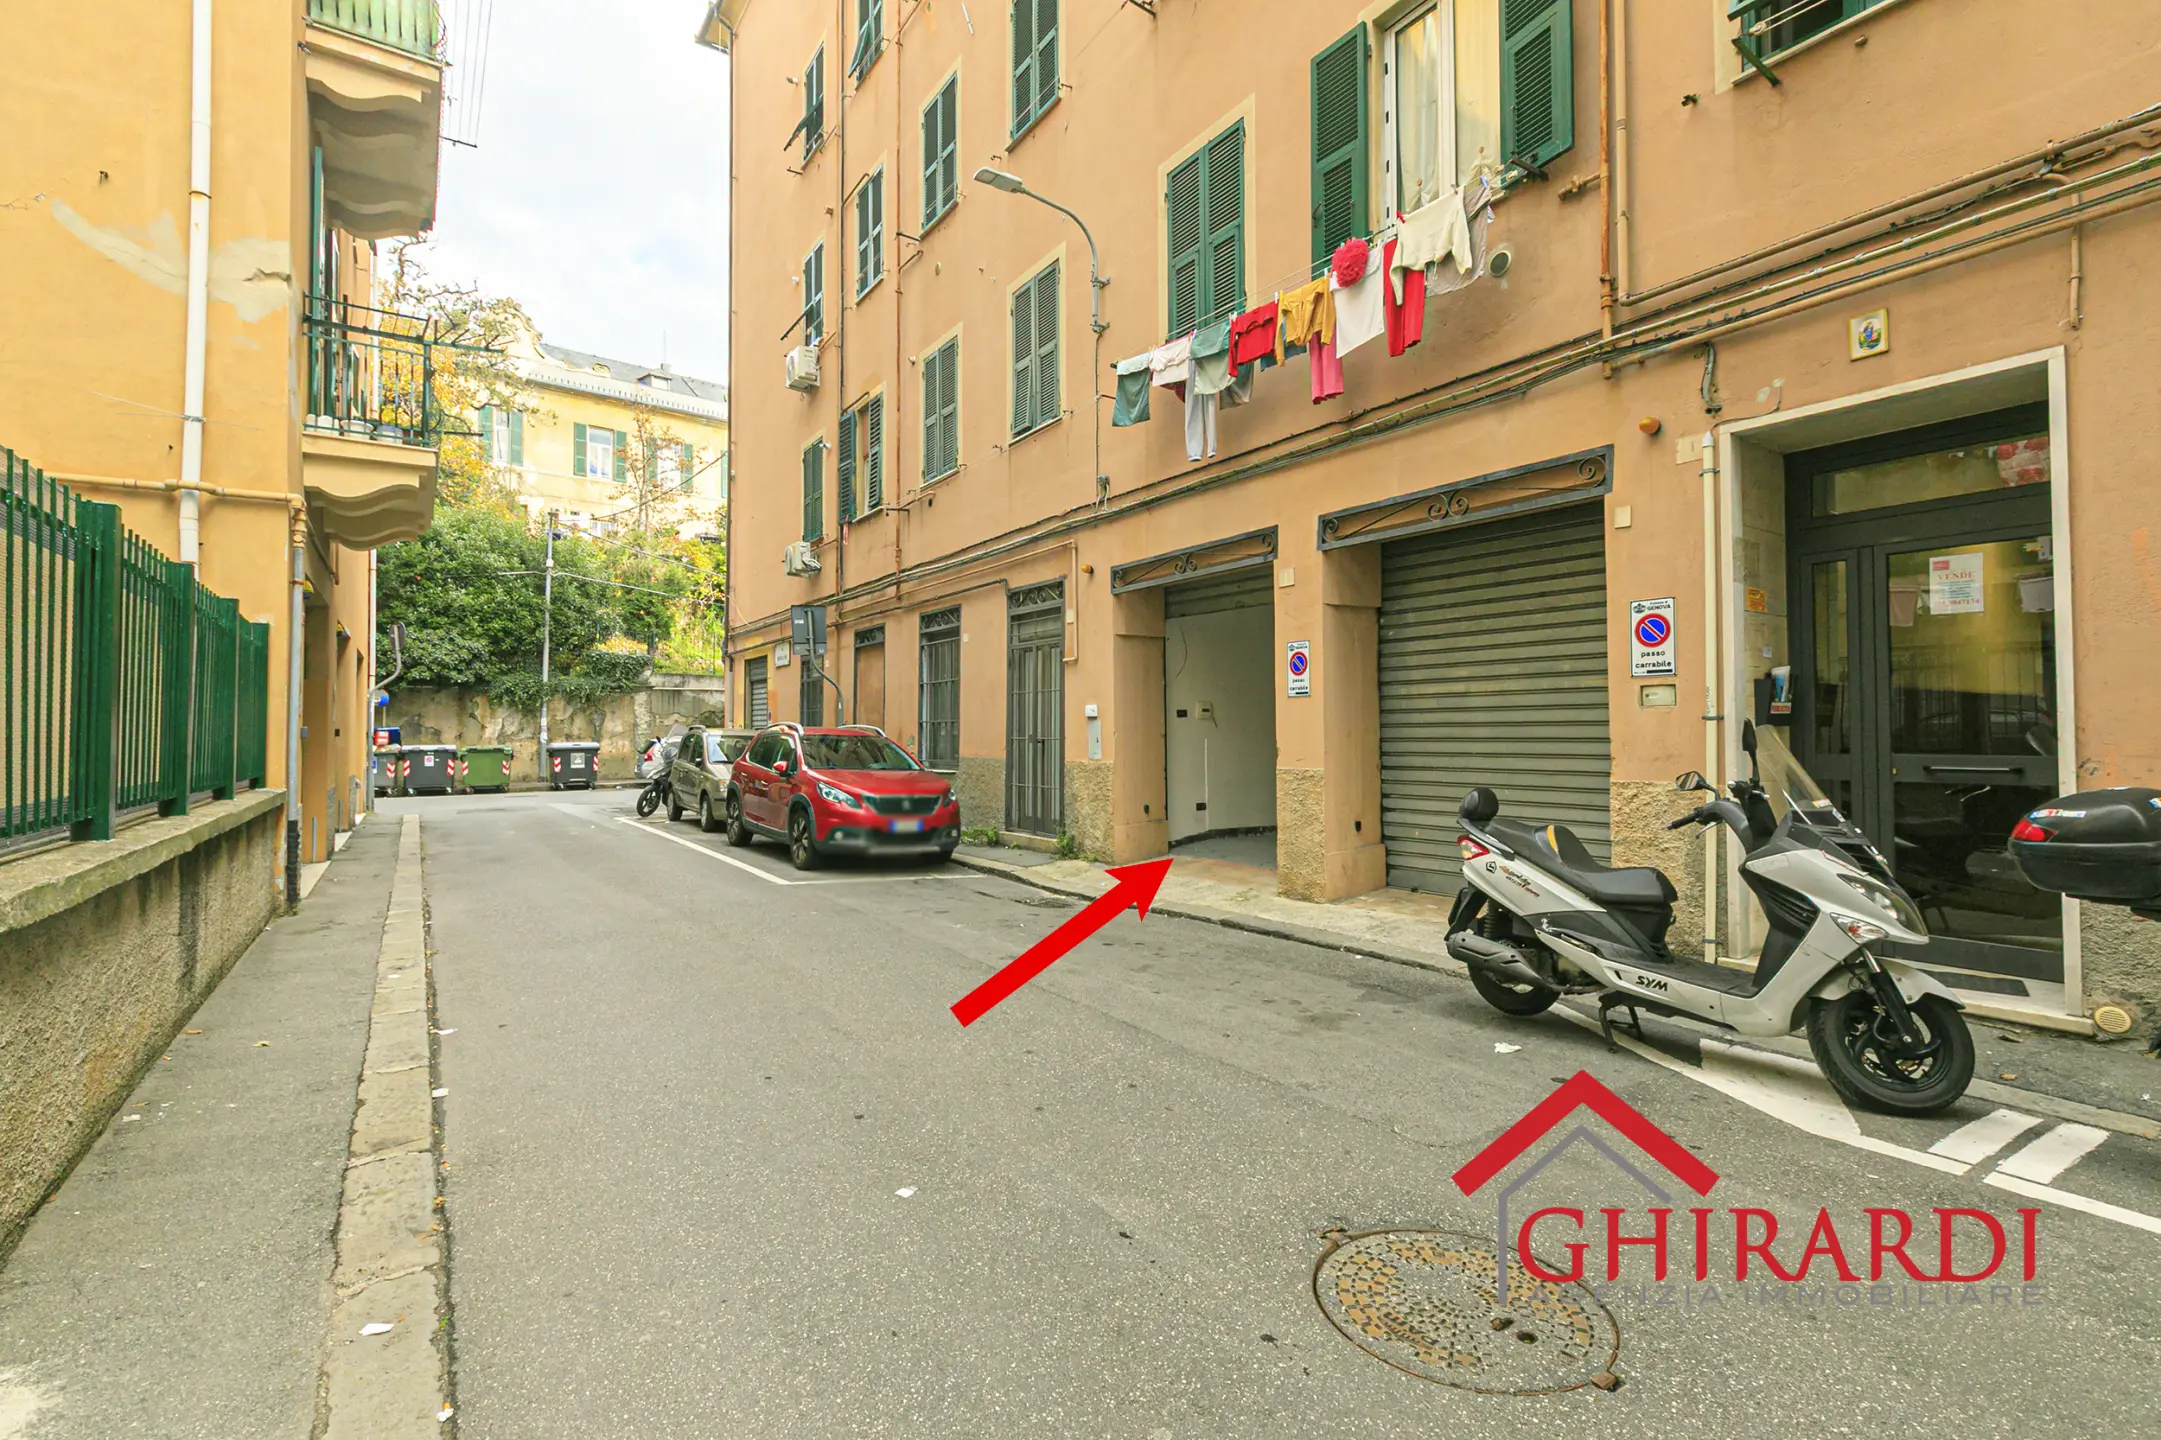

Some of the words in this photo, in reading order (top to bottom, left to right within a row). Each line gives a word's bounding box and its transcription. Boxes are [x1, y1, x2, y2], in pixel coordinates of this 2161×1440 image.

[1938, 571, 1973, 580] VENDE
[1635, 660, 1672, 669] carrabile
[1636, 975, 1668, 992] SYM
